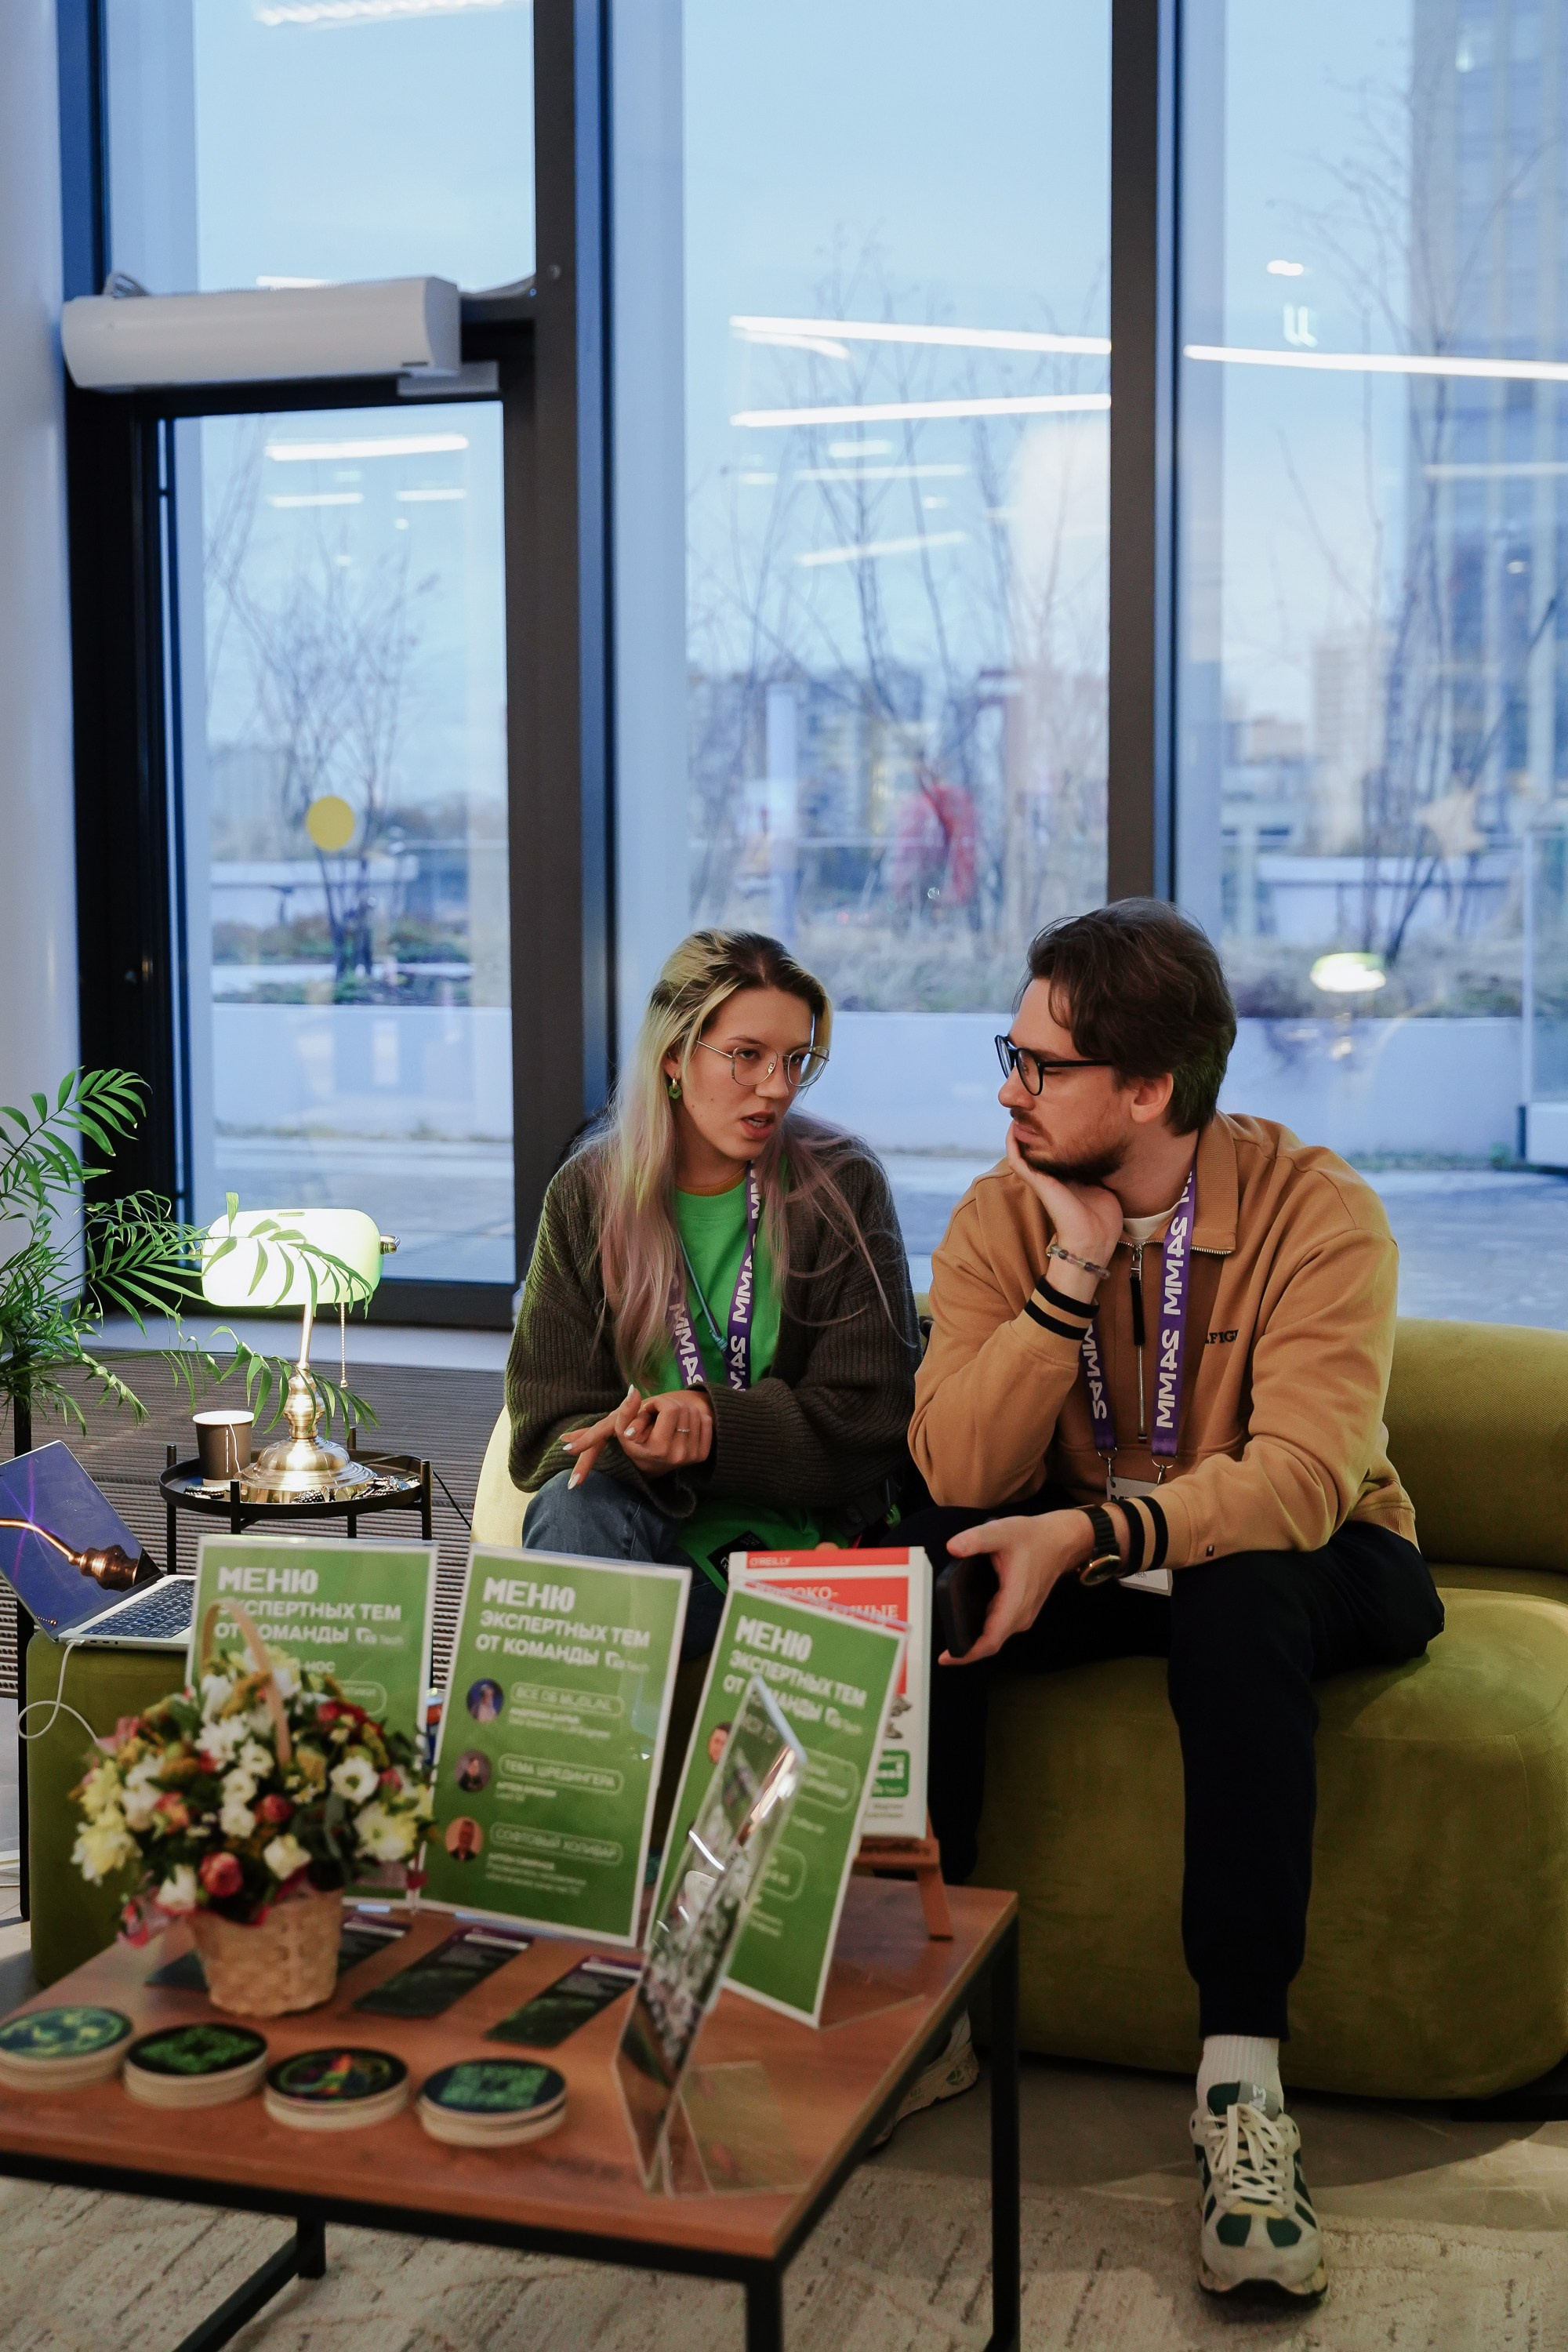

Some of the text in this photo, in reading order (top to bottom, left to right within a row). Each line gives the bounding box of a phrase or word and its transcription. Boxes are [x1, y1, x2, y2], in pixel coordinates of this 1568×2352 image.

[217, 1567, 318, 1594] МЕНЮ
[482, 1576, 576, 1613] МЕНЮ
[361, 1604, 401, 1621] ТЕМ
[480, 1610, 650, 1648] ЭКСПЕРТНЫХ ТЕМ
[214, 1623, 240, 1639] ОТ
[258, 1624, 350, 1643] ОМАНДЫ
[735, 1615, 813, 1662] МЕНЮ
[475, 1634, 502, 1653] ОТ
[503, 1637, 600, 1667] КОМАНДЫ
[723, 1674, 745, 1694] ОТ
[729, 1649, 867, 1709] ЭКСПЕРТНЫХ ТЕМ
